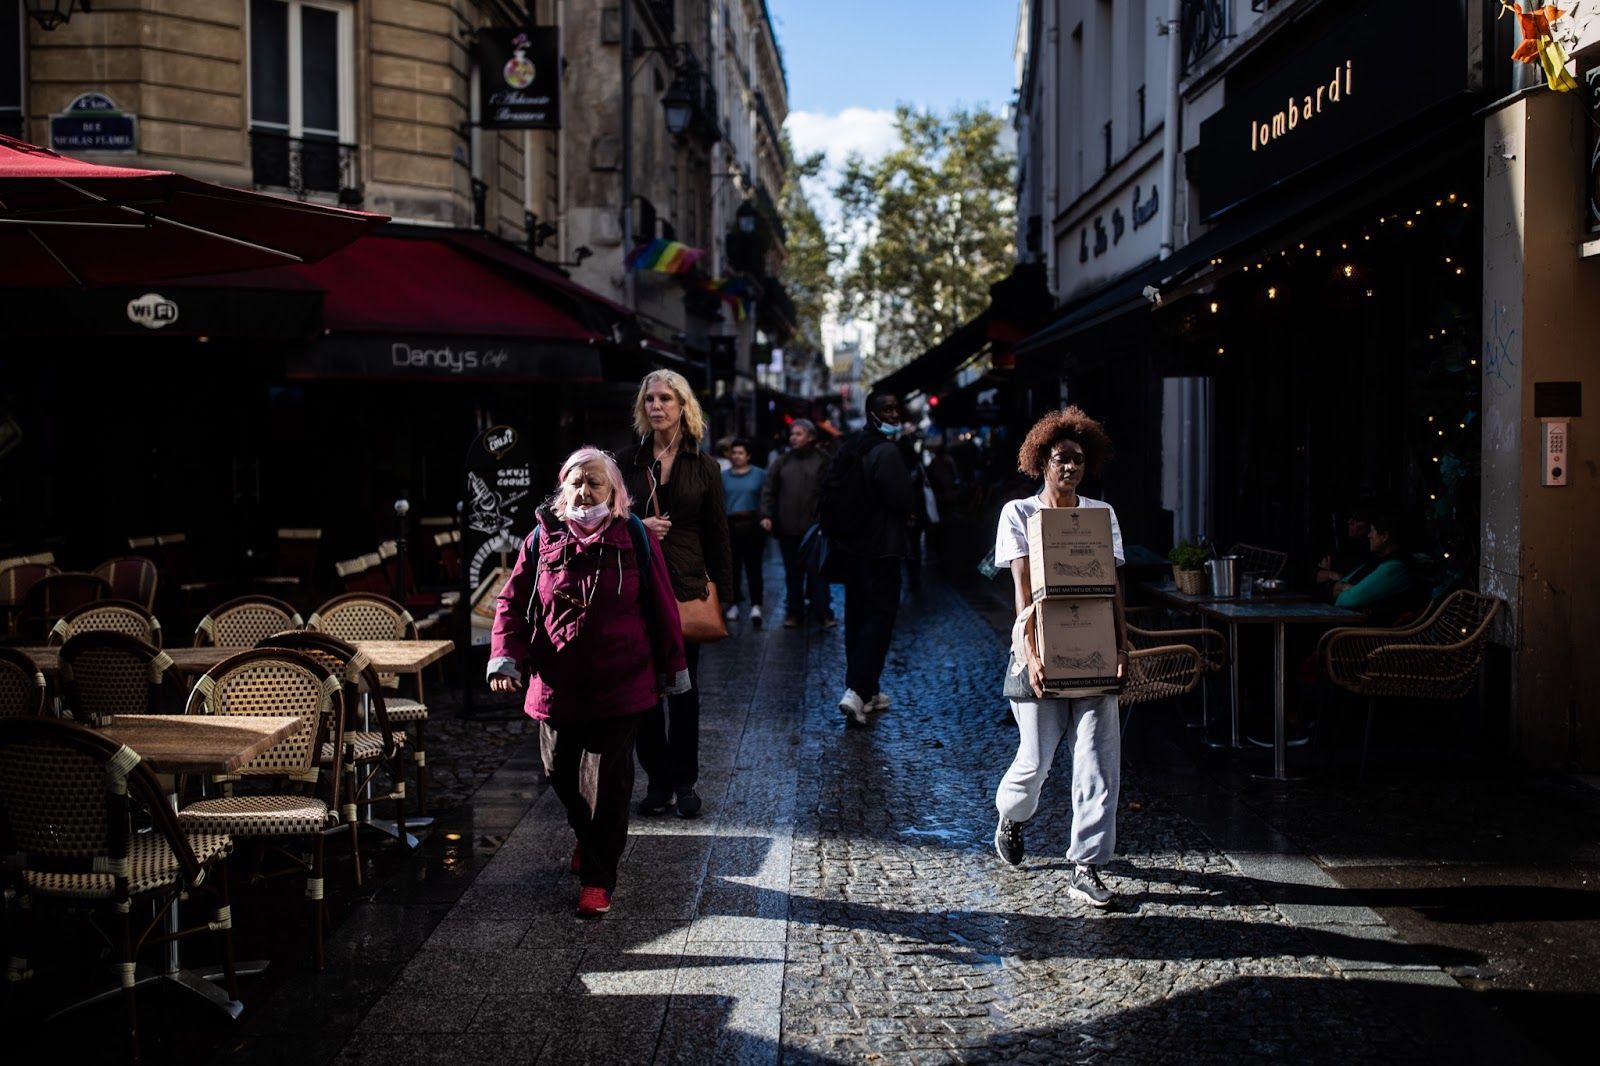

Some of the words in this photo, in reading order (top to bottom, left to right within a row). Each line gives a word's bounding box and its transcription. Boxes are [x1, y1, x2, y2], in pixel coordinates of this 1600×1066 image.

[1251, 59, 1352, 151] lombardi
[82, 122, 102, 132] RUE
[54, 136, 93, 145] NICOLAS
[95, 136, 131, 145] FLAMEL
[391, 342, 478, 374] Dandys
